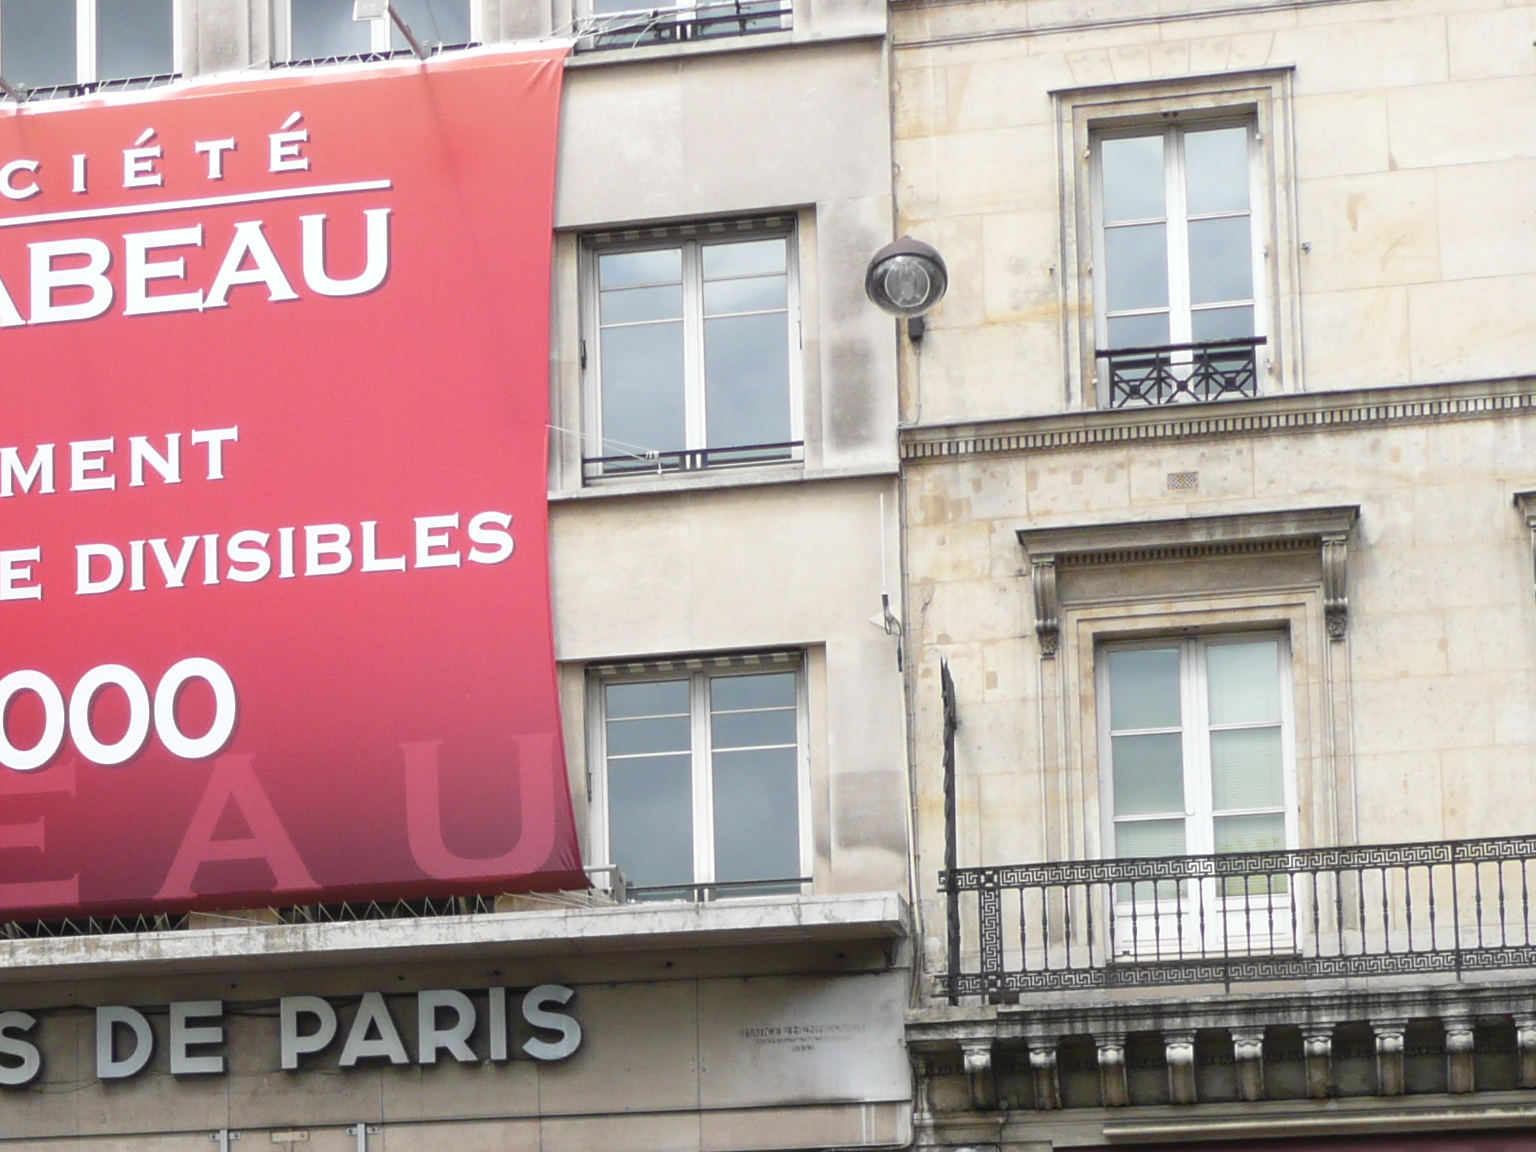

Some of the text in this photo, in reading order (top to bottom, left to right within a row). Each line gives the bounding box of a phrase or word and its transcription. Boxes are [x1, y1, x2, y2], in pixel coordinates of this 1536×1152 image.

[74, 510, 516, 597] DIVISIBLES
[96, 1000, 225, 1080] DE
[280, 985, 582, 1070] PARIS
